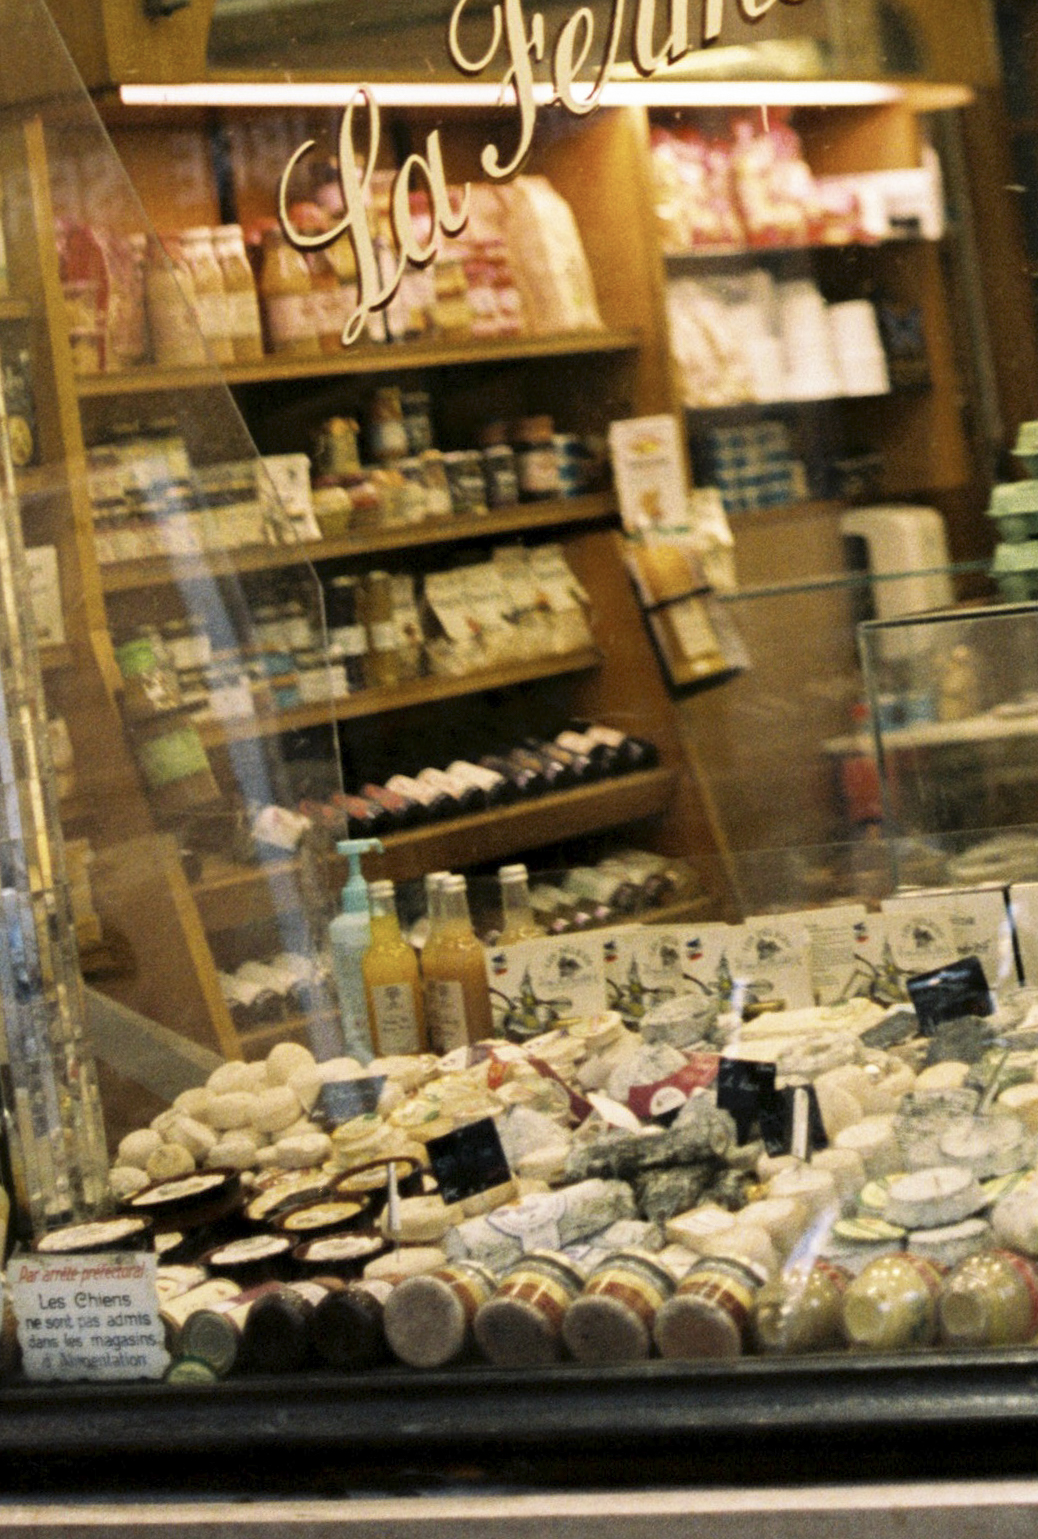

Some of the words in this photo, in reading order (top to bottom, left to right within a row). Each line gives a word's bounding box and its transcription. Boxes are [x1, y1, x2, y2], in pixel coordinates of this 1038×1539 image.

[278, 83, 472, 346] La
[18, 1264, 39, 1284] Par
[38, 1292, 67, 1311] Les
[74, 1291, 132, 1309] Chiens
[26, 1317, 42, 1330] ne
[46, 1314, 74, 1329] sont
[78, 1316, 101, 1332] pas
[106, 1312, 152, 1328] admis
[28, 1334, 59, 1349] dans
[64, 1332, 83, 1348] les
[91, 1330, 157, 1351] magasins
